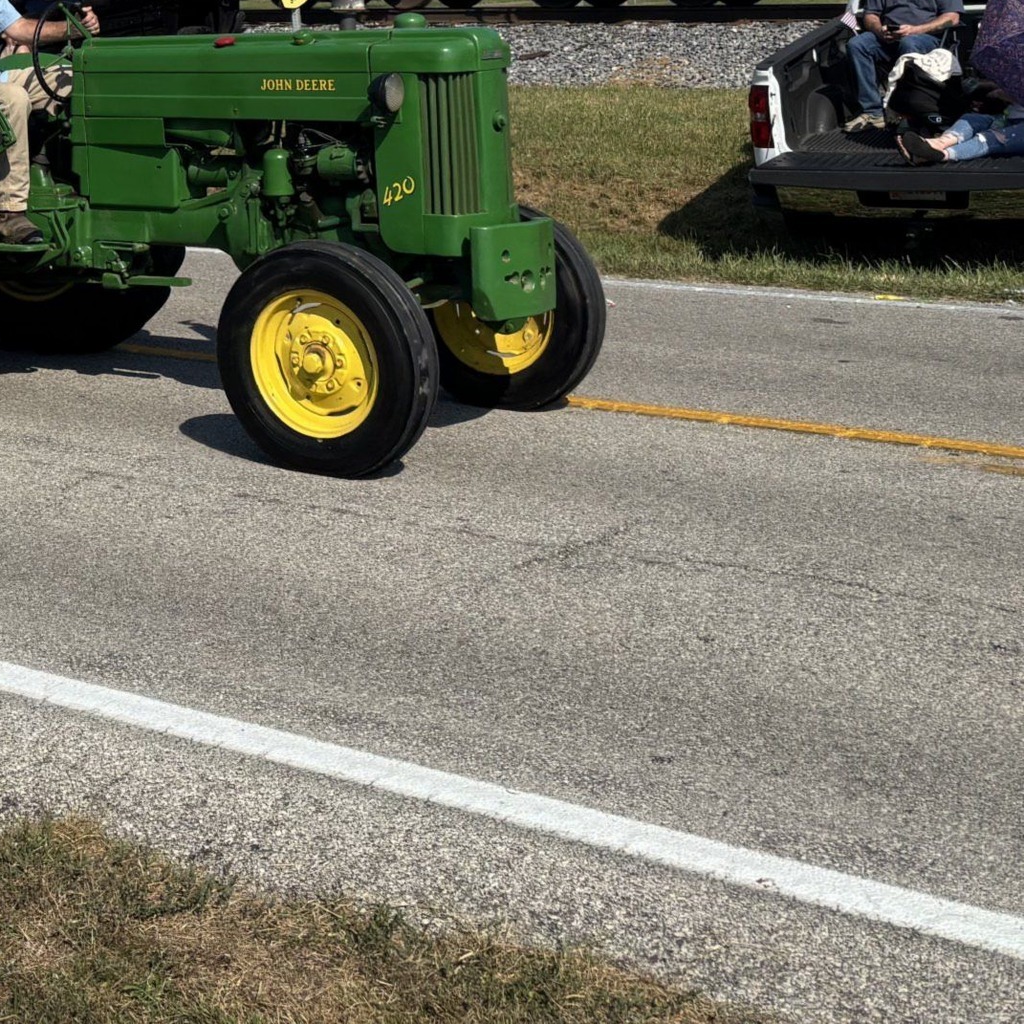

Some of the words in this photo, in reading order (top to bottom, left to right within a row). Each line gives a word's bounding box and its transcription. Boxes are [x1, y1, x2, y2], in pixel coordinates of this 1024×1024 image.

[260, 79, 292, 91] JOHN
[295, 79, 336, 91] DEERE
[382, 176, 415, 207] 420
